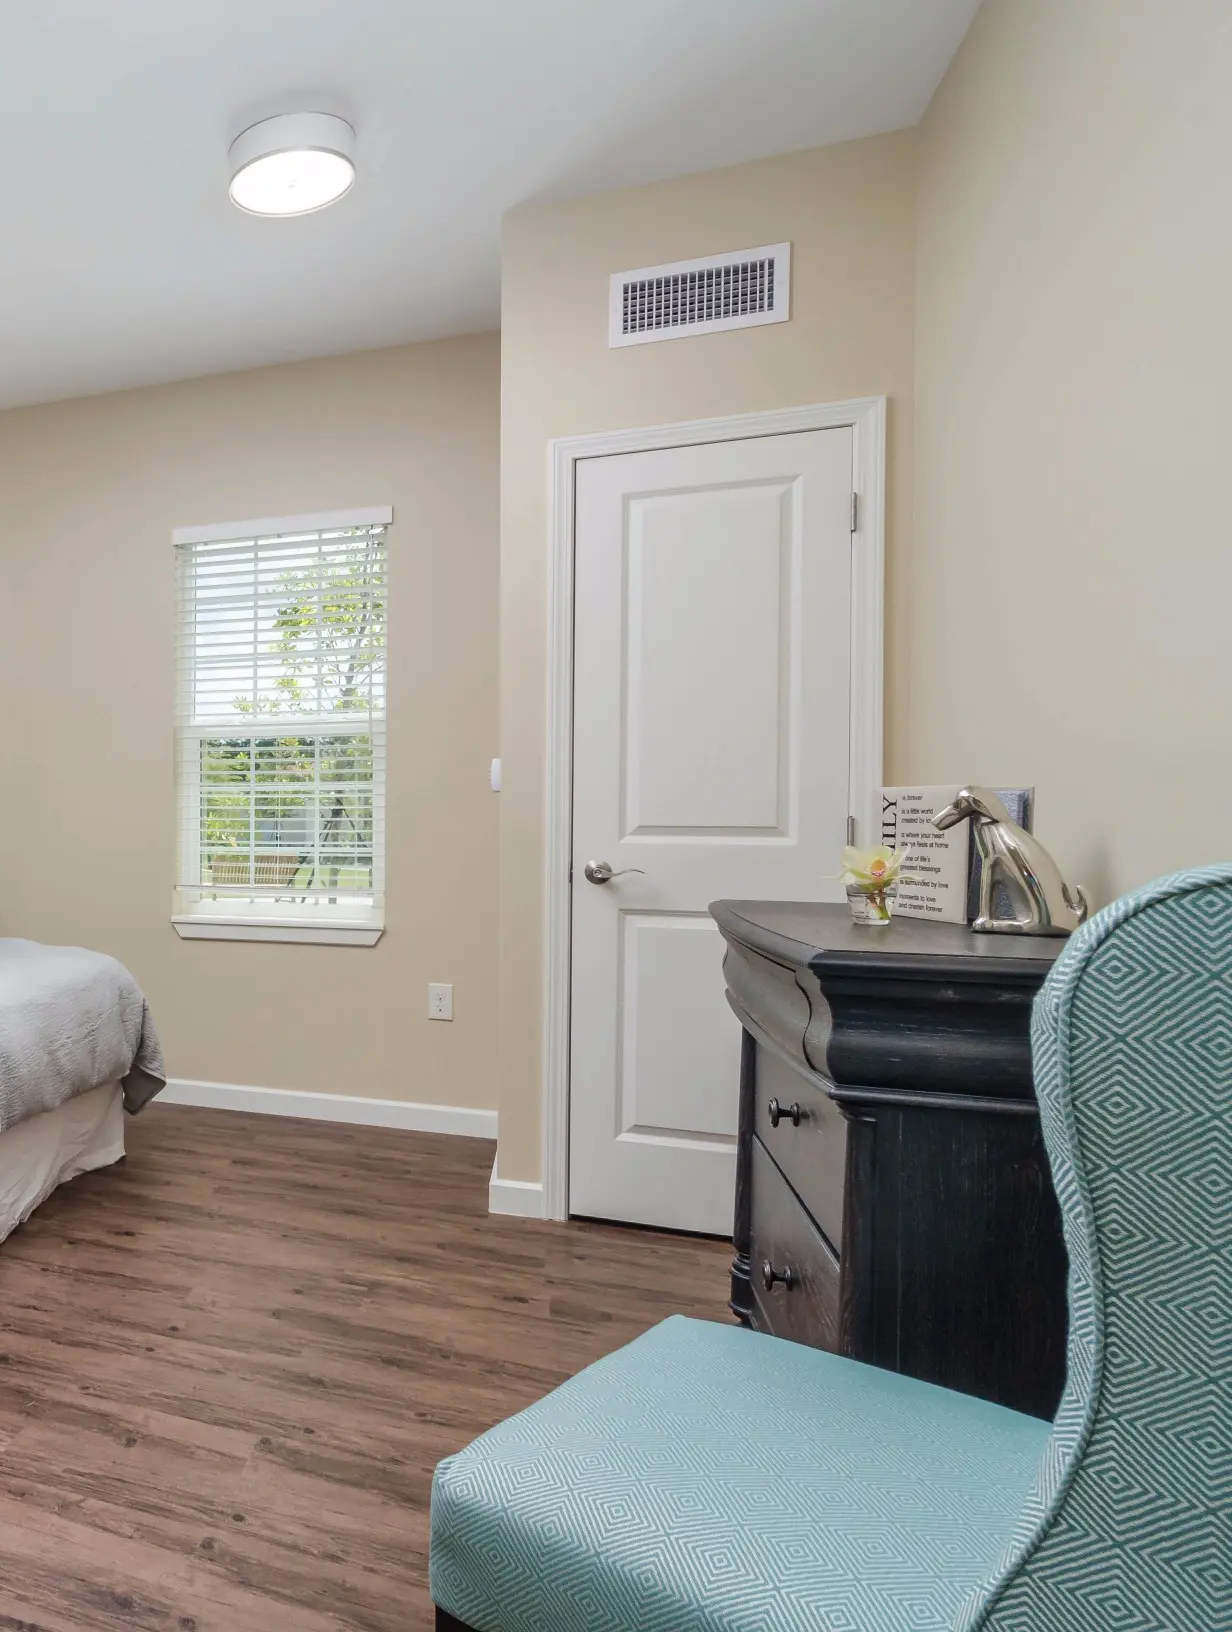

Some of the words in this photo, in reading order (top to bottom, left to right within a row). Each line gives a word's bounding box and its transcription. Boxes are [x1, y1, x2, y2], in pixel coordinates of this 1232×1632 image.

[910, 807, 920, 815] little
[918, 817, 925, 825] by
[919, 855, 931, 863] life's
[918, 865, 941, 874] blessings
[904, 880, 930, 888] surrounded
[930, 881, 937, 889] by
